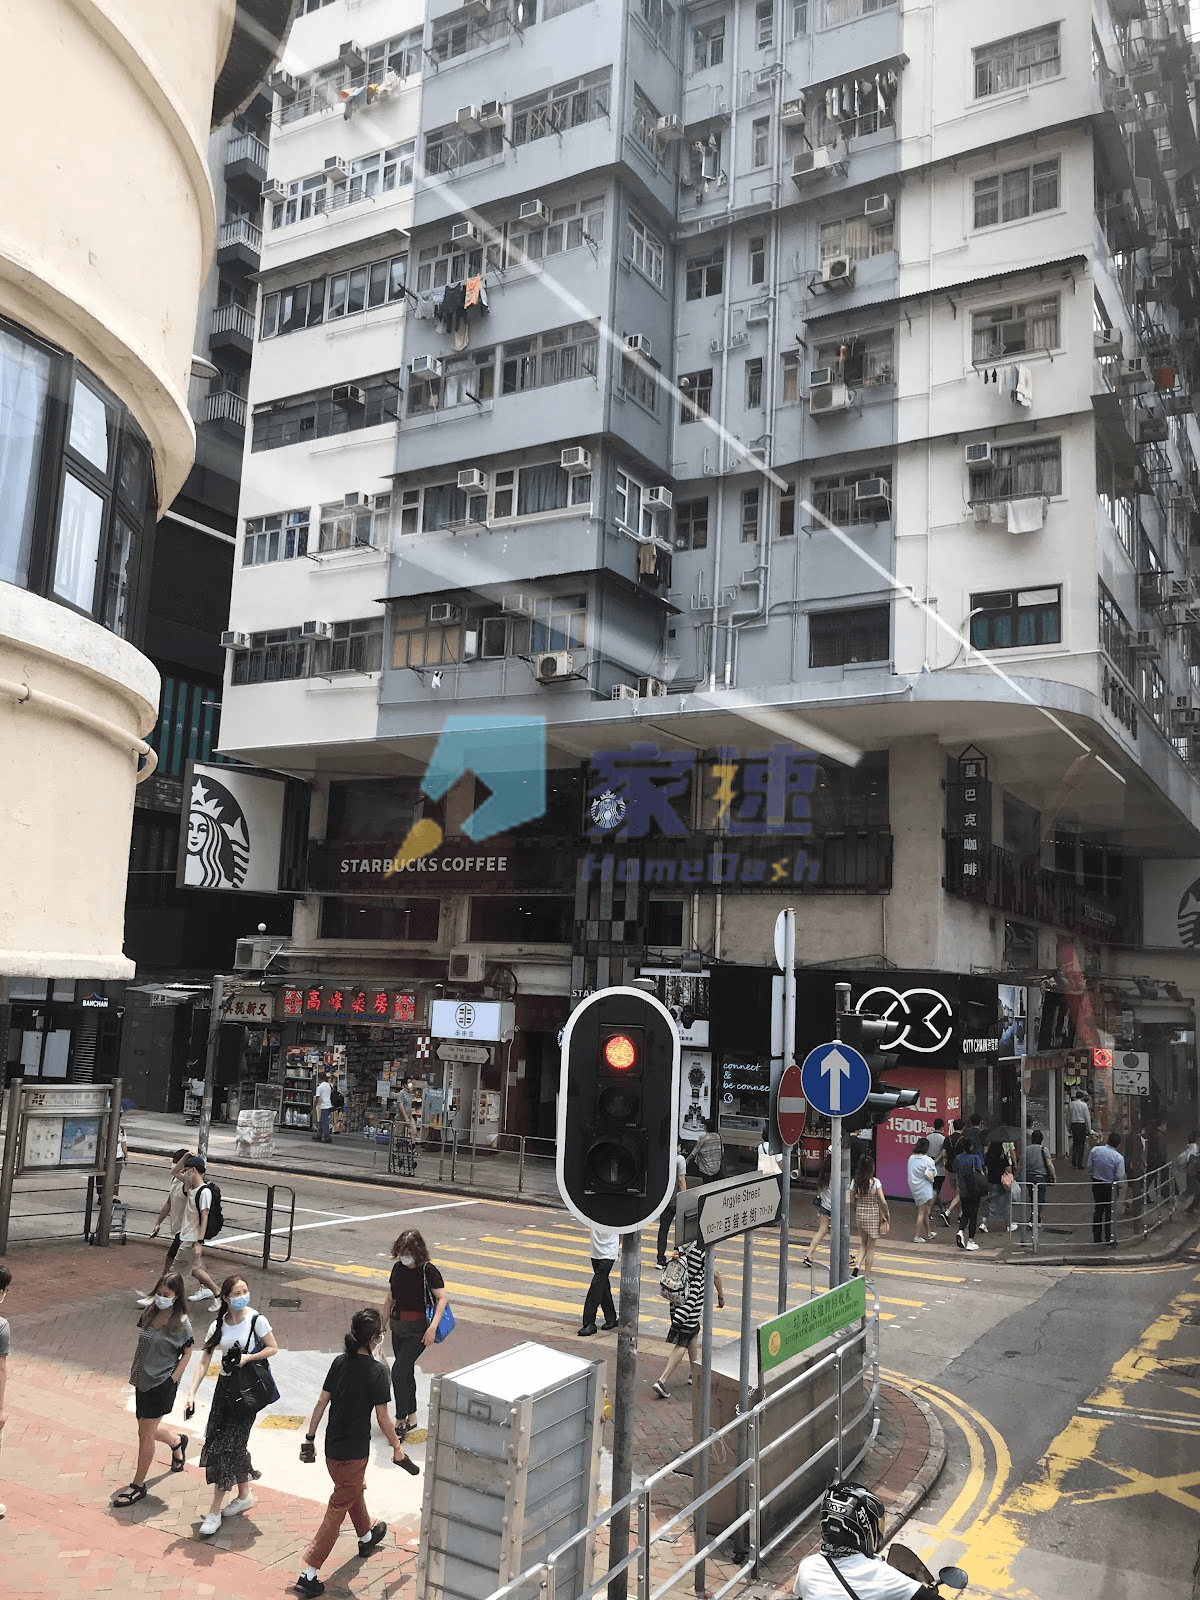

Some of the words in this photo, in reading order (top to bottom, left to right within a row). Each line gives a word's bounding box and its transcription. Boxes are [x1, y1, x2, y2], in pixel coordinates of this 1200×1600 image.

[963, 764, 978, 876] 星巴克咖啡
[340, 857, 438, 873] STARBUCKS
[441, 856, 508, 872] COFFEE
[82, 1000, 109, 1008] BANCHAN
[962, 1039, 974, 1053] CITY
[974, 1038, 987, 1052] CHAIN
[723, 1062, 762, 1071] connect
[723, 1071, 732, 1079] &
[1136, 1072, 1142, 1080] 7
[723, 1082, 736, 1090] be
[1137, 1086, 1148, 1094] 12
[722, 1193, 741, 1209] Argyle
[742, 1188, 761, 1202] Street
[723, 1207, 757, 1233] 亞皆老街
